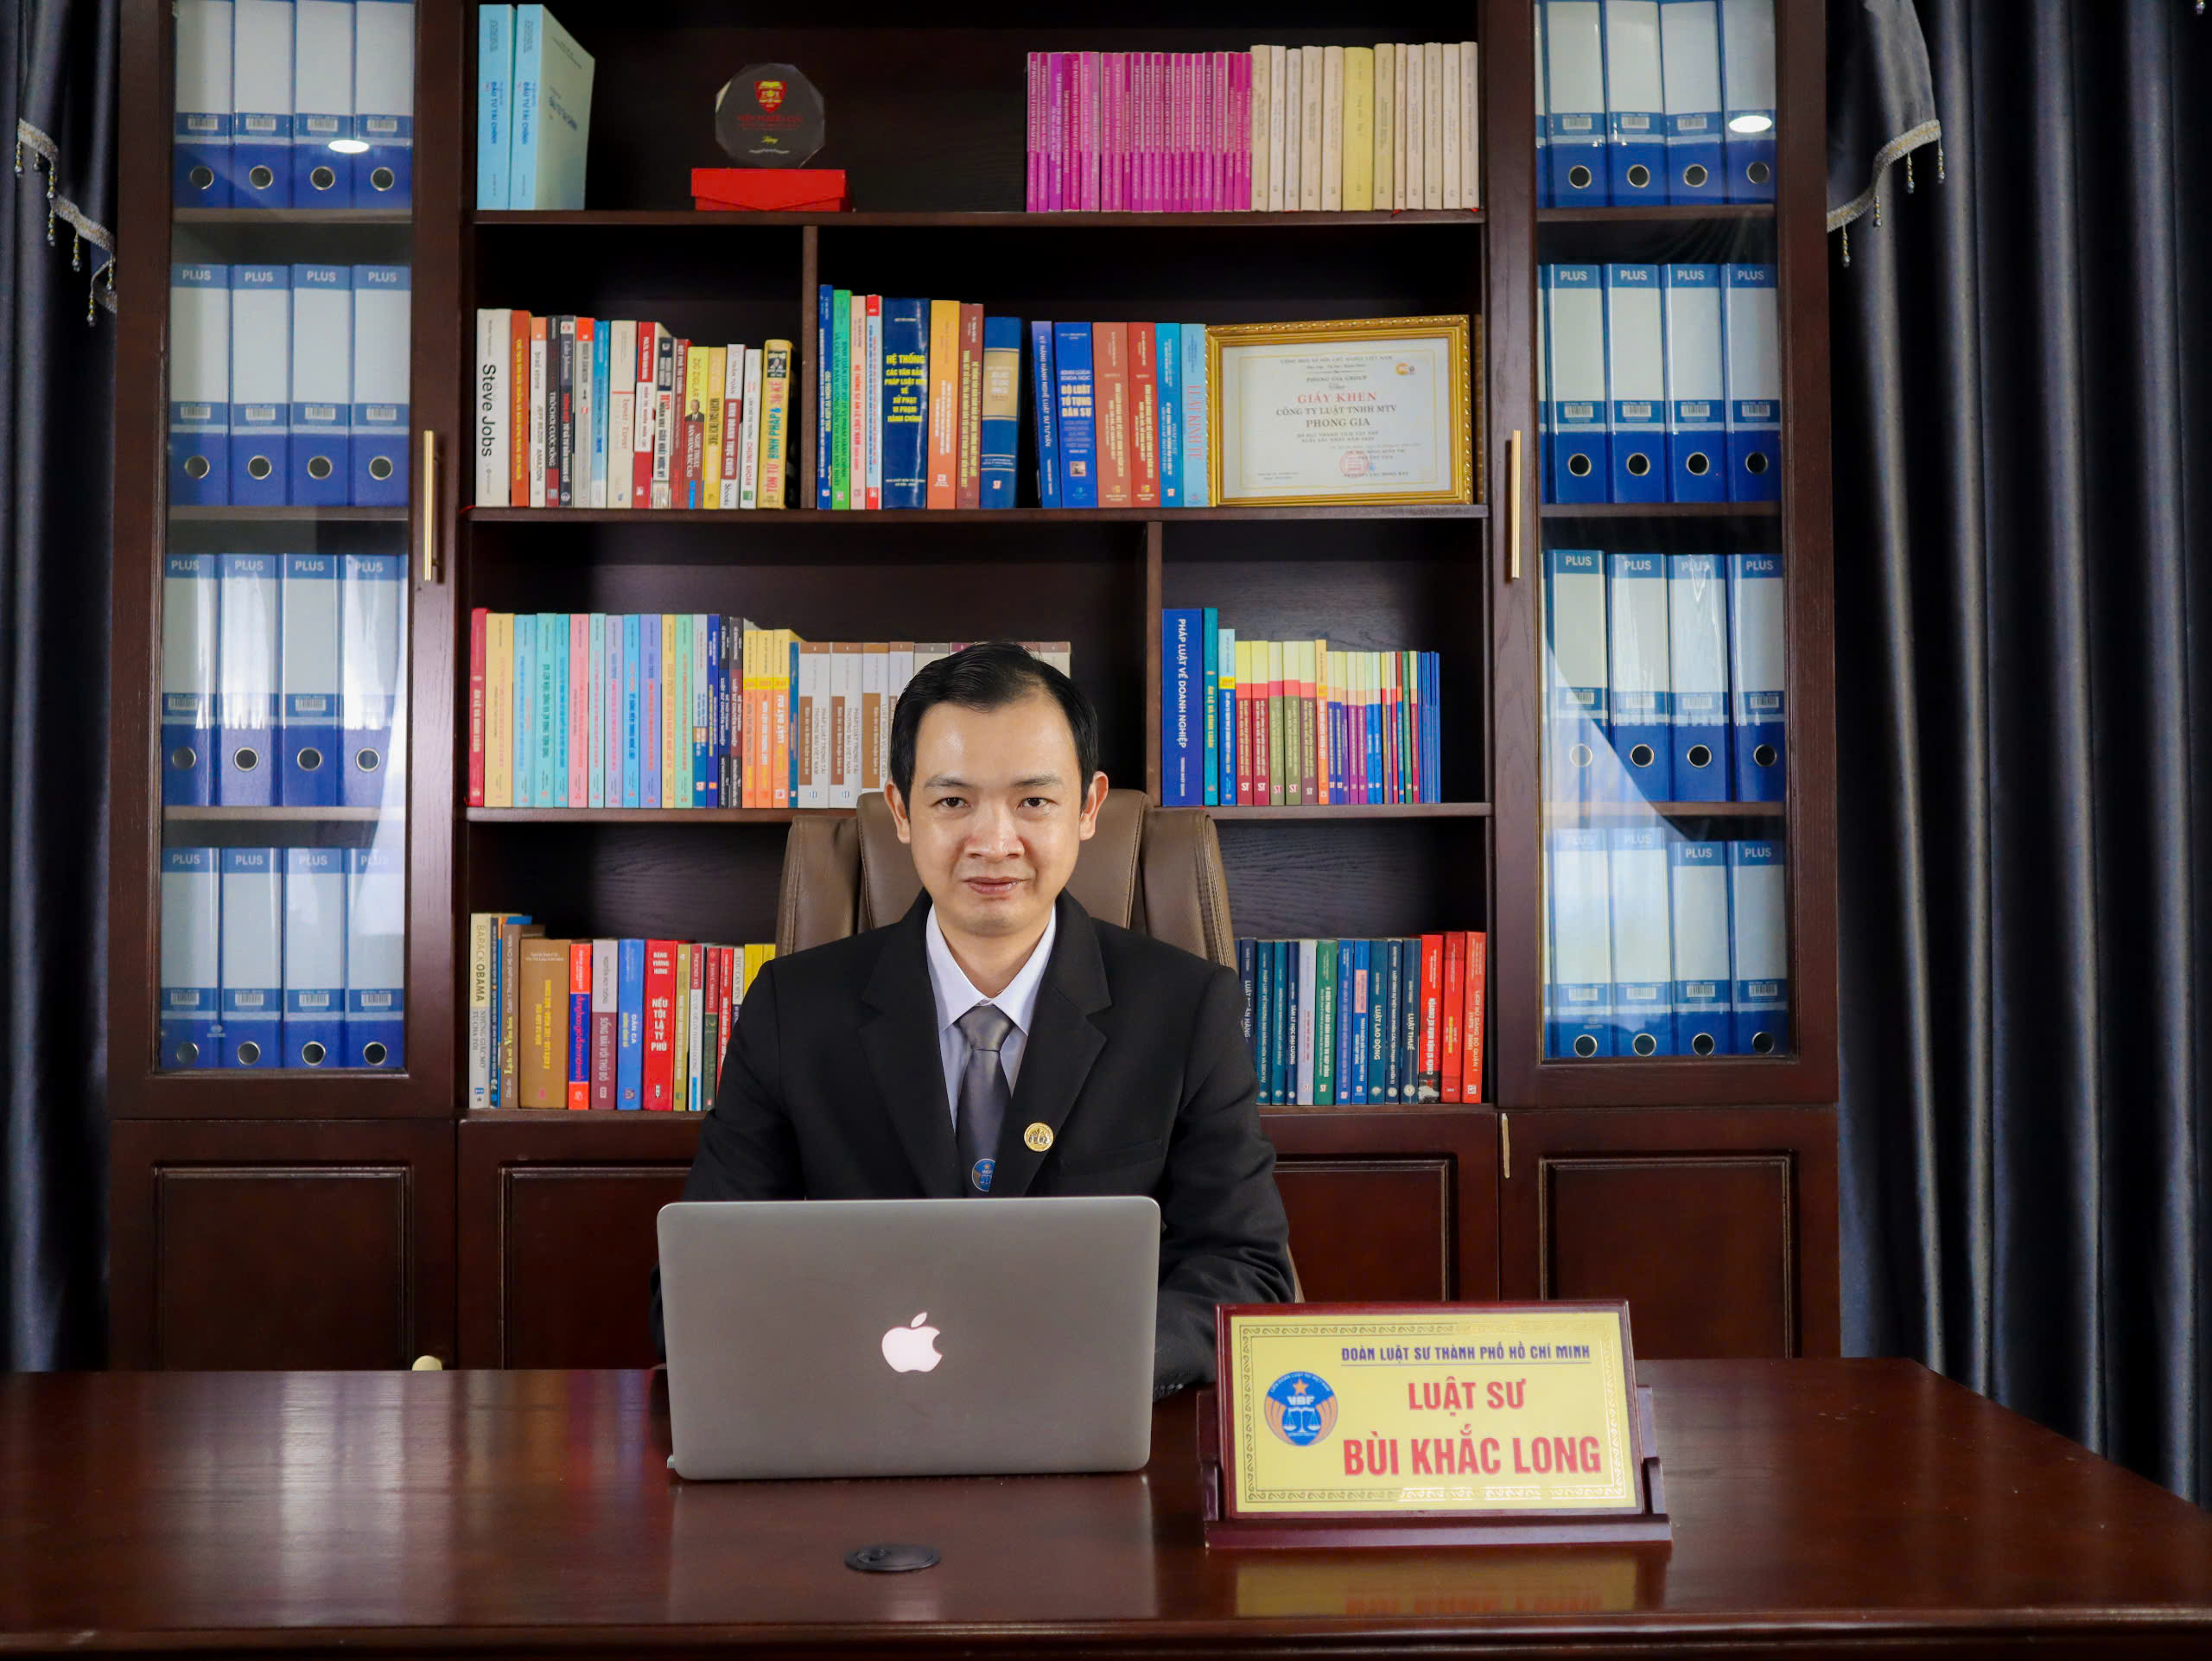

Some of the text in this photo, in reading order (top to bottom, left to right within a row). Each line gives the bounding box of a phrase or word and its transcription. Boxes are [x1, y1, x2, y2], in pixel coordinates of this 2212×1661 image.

[182, 270, 212, 282] PLUS
[245, 271, 273, 282] PLUS
[307, 270, 336, 282] PLUS
[368, 271, 397, 283] PLUS
[1560, 270, 1587, 281] PLUS
[1621, 270, 1647, 281] PLUS
[1677, 270, 1705, 281] PLUS
[1738, 270, 1764, 281] PLUS
[1298, 391, 1376, 404] GIẤY KHEN
[481, 364, 497, 457] Steve Jobs
[1276, 404, 1397, 416] CÔNG TY LUẬT TNHH MTV
[1187, 385, 1204, 461] LUẬT KINH TẾ
[1306, 417, 1370, 428] PHONG GIA
[172, 560, 200, 571] PLUS
[235, 560, 264, 571] PLUS
[296, 561, 324, 571] PLUS
[353, 561, 385, 572] PLUS
[1565, 556, 1592, 566] PLUS
[1624, 560, 1651, 570] PLUS
[1681, 560, 1710, 570] PLUS
[1746, 560, 1774, 570] PLUS
[1176, 619, 1188, 748] PHÁP LUẬT VỀ DOANH NGHIỆP
[1624, 835, 1652, 844] PLUS
[1685, 848, 1713, 858] PLUS
[1745, 847, 1772, 858] PLUS
[173, 855, 200, 865] PLUS
[235, 855, 264, 865] PLUS
[299, 856, 327, 866] PLUS
[475, 925, 486, 1002] BARACK OBAMA
[652, 996, 669, 1009] NẾU
[653, 1007, 666, 1019] TÔI
[651, 1040, 668, 1053] PHÚ
[1341, 1340, 1591, 1364] ĐOÀN LUẬT SƯ THÀNH PHỐ HỒ CHÍ MINH
[1287, 1396, 1315, 1405] VBF
[1408, 1375, 1527, 1416] LUẬT SƯ
[1343, 1422, 1603, 1477] BÙI KHẮC LONG
